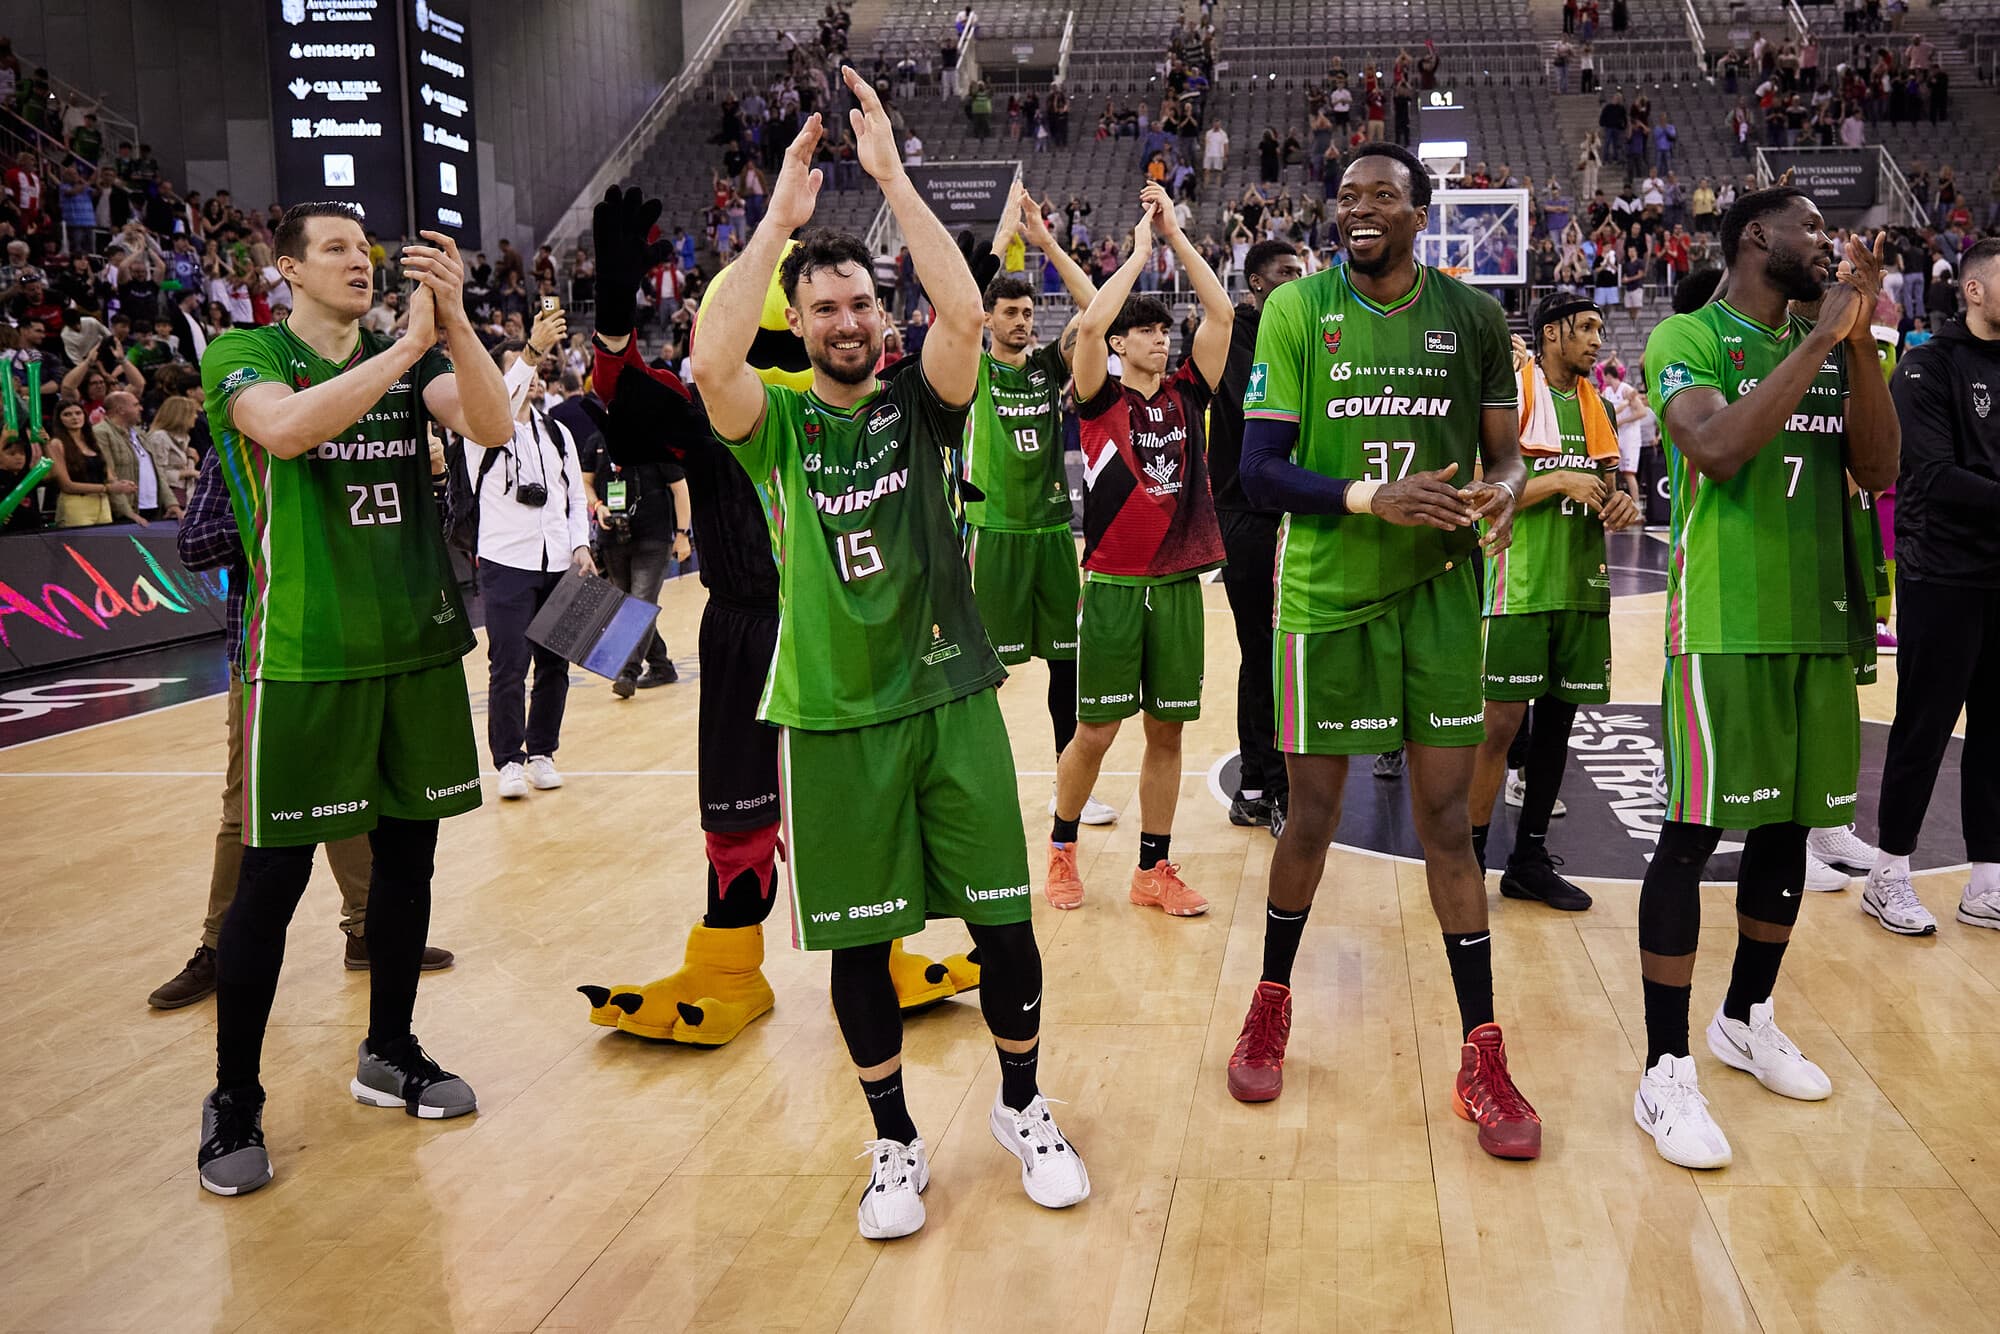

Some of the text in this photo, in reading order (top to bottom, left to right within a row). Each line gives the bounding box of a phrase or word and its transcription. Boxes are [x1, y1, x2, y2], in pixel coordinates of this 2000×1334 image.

[303, 44, 376, 60] emasagra
[1430, 91, 1453, 106] 0.1
[1320, 313, 1345, 324] vive
[1330, 362, 1448, 381] 65 ANIVERSARIO
[1145, 406, 1164, 422] 10
[1013, 428, 1040, 452] 19
[1362, 441, 1416, 485] 37
[1783, 456, 1803, 498] 7
[346, 482, 402, 526] 29
[836, 529, 885, 582] 15
[1509, 675, 1538, 683] asisa
[1566, 682, 1604, 690] BERNER
[1100, 694, 1128, 704] asisa
[1317, 718, 1388, 730] vive asisa
[1442, 712, 1484, 726] BERNE
[437, 777, 480, 798] BERNER
[708, 795, 767, 811] vive asisa
[1722, 793, 1750, 804] vive
[271, 801, 358, 821] vive asisa
[977, 885, 1029, 900] BERNE
[811, 900, 895, 923] vive asisa
